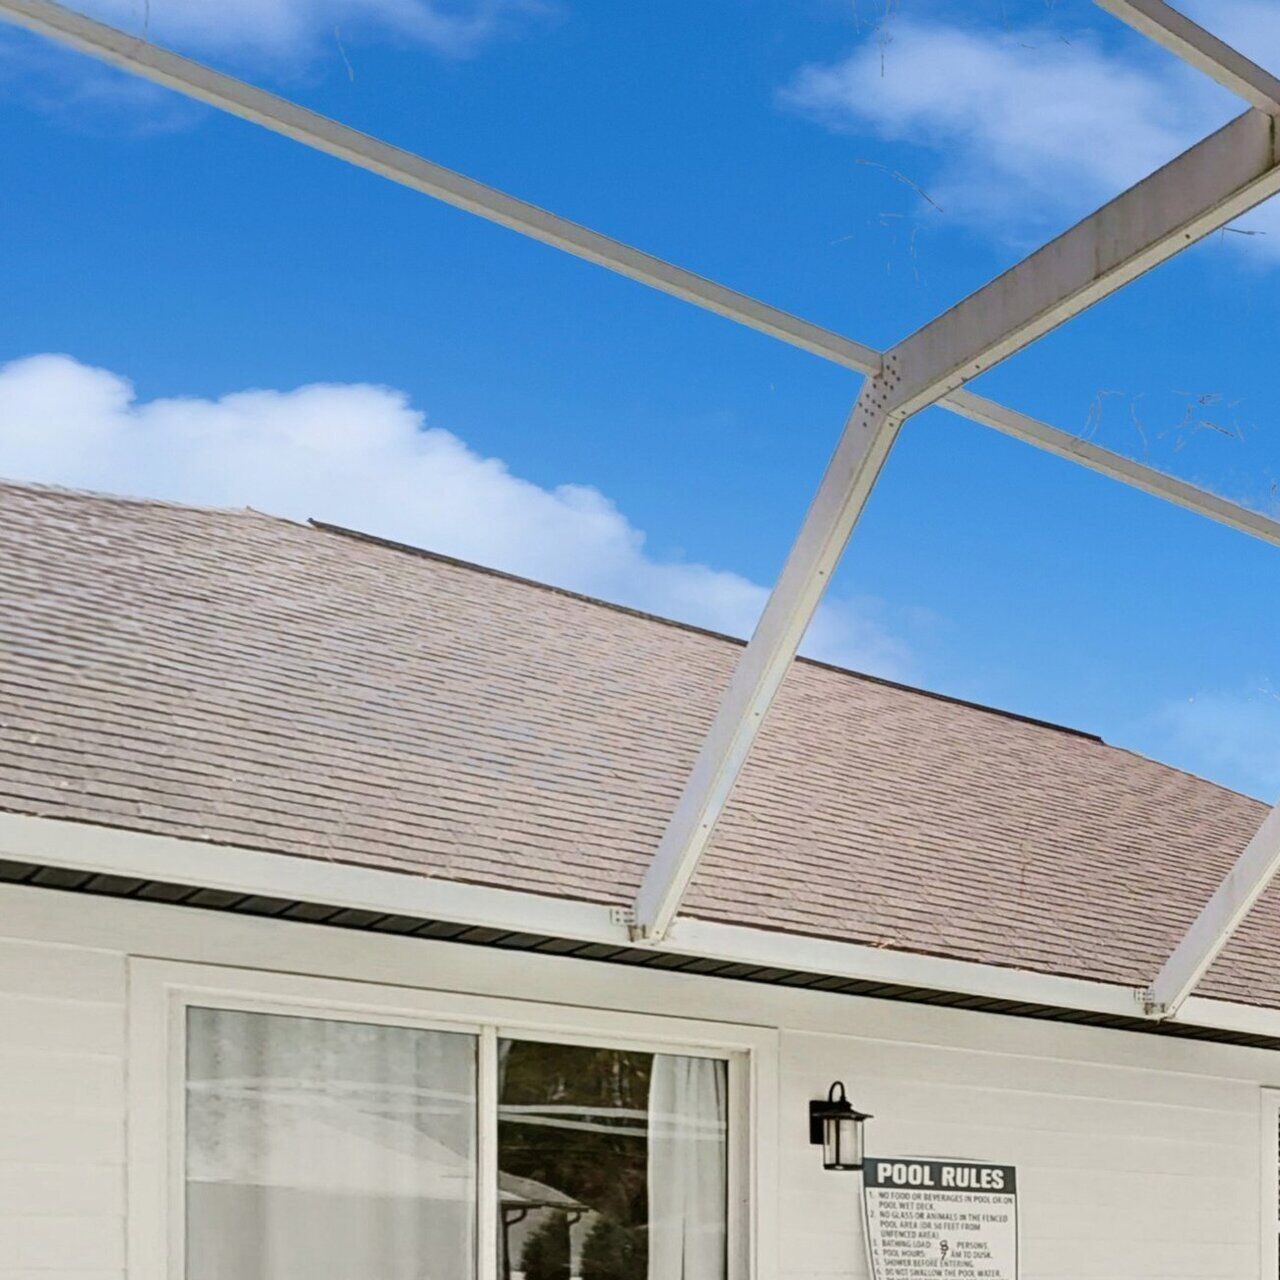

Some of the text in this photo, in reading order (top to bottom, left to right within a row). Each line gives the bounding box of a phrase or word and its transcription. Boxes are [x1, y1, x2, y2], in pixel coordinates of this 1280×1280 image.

[877, 1162, 1005, 1190] POOL RULES
[890, 1191, 910, 1200] FOOD
[911, 1192, 921, 1200] OR
[923, 1193, 963, 1203] BEVERAGES
[973, 1195, 991, 1204] POOL
[879, 1200, 897, 1209] POOL
[891, 1211, 914, 1220] GLASS
[926, 1212, 958, 1221] ANIMALS
[968, 1214, 981, 1222] THE
[982, 1214, 1008, 1223] FENCED
[880, 1220, 898, 1229] POOL
[900, 1221, 917, 1229] AREA
[943, 1222, 960, 1231] FEET
[960, 1222, 981, 1231] FROM
[881, 1230, 917, 1238] UNFENCED
[881, 1239, 911, 1247] BATHING
[939, 1239, 949, 1251] 8
[883, 1249, 899, 1257] POOL
[940, 1250, 948, 1261] 7
[884, 1258, 912, 1266] SHOWER
[913, 1259, 938, 1267] BEFORE
[910, 1269, 943, 1277] SWALLOW
[958, 1270, 976, 1278] POOL
